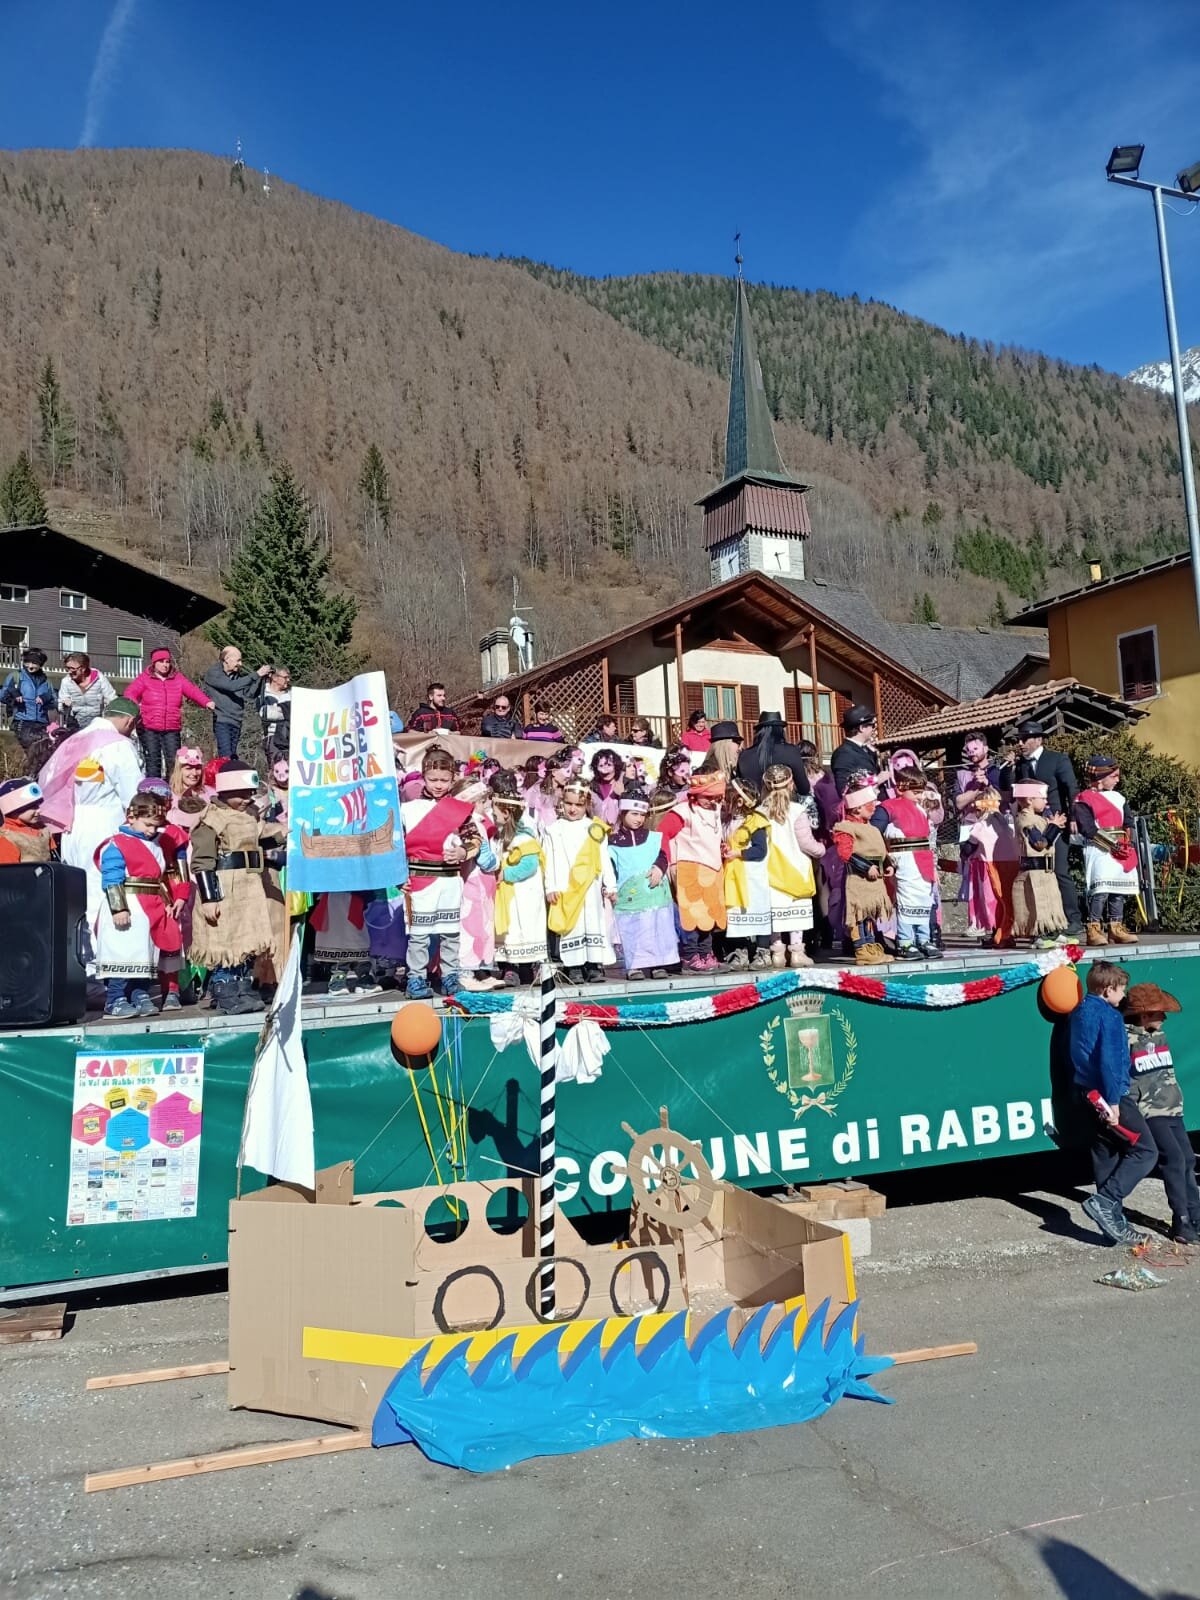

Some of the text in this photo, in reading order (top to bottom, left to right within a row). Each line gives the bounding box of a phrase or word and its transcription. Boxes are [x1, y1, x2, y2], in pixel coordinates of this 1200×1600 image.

[313, 700, 378, 738] ULISE
[302, 727, 368, 761] ULISE
[84, 1057, 198, 1077] CARNEVALE
[88, 1079, 100, 1087] Val
[102, 1078, 110, 1087] di
[832, 1118, 880, 1165] di
[900, 1098, 1055, 1156] RABBI
